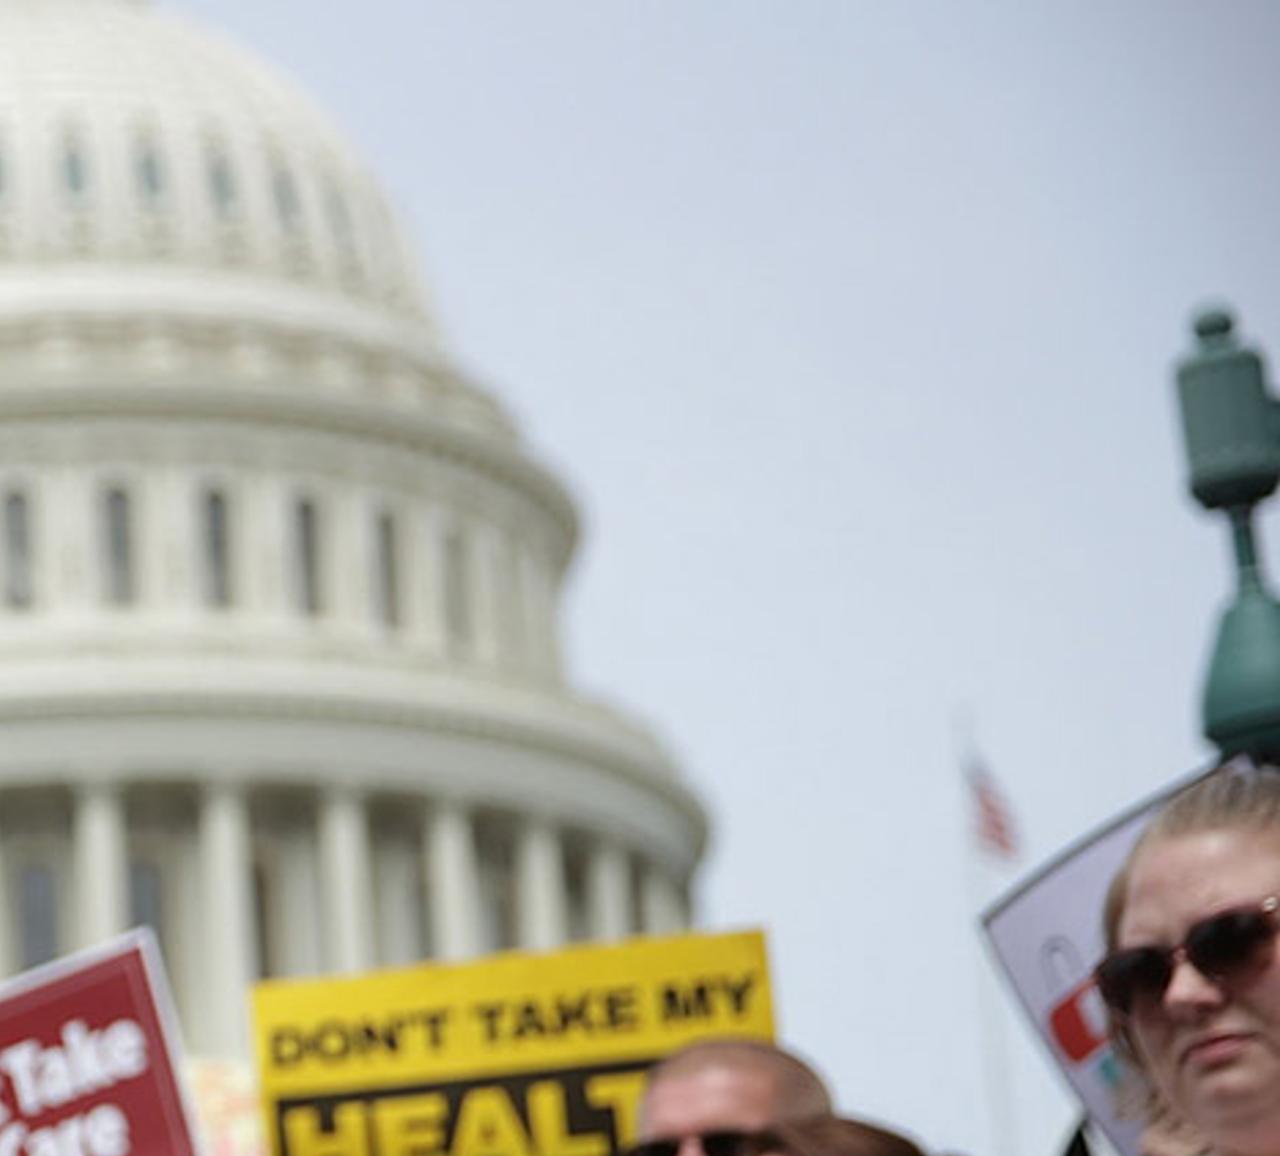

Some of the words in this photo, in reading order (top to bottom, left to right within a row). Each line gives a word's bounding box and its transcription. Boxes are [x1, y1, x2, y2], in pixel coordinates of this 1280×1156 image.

[270, 1004, 446, 1066] DON'T
[480, 986, 636, 1042] TAKE
[662, 974, 756, 1022] MY
